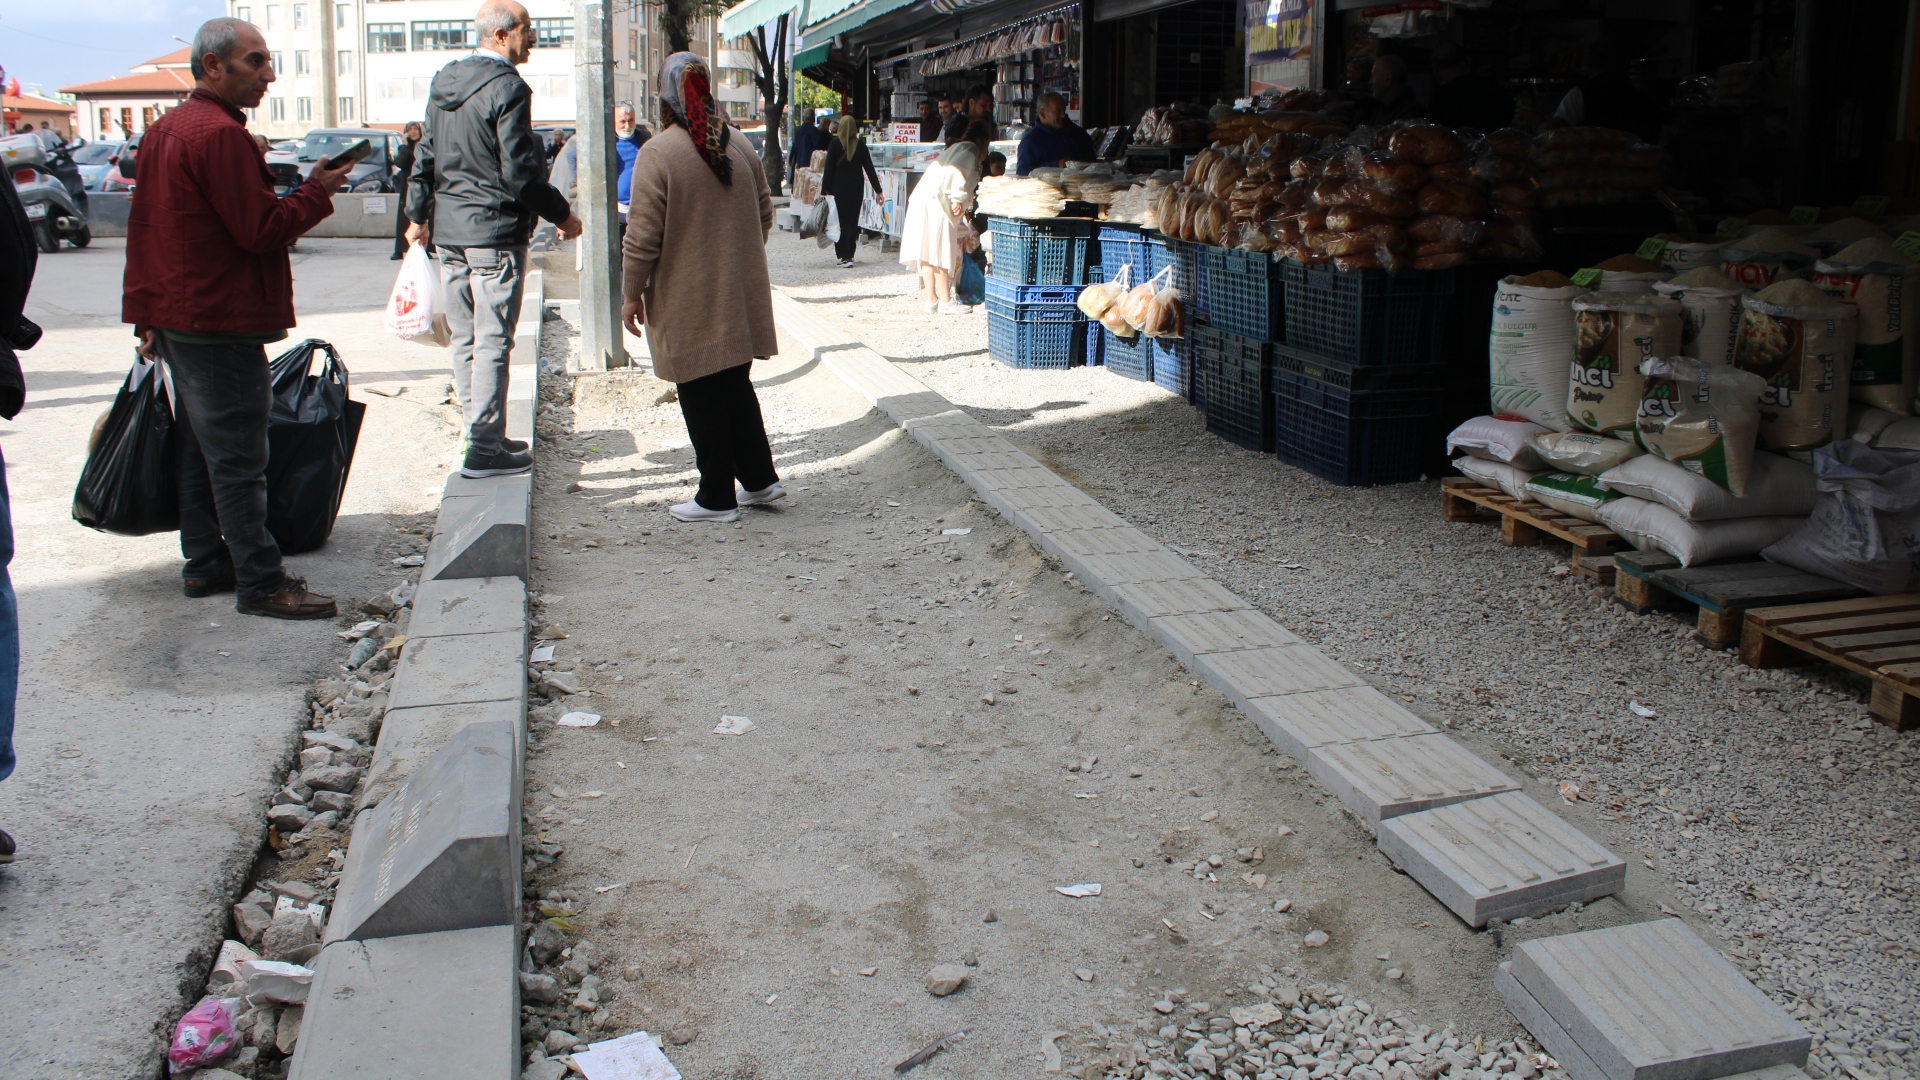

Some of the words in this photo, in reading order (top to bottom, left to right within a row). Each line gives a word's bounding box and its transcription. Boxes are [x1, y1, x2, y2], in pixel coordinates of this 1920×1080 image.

[1282, 18, 1301, 49] TAZE
[895, 135, 908, 143] 50
[1726, 301, 1740, 364] SMANCIK
[1888, 306, 1902, 333] Yerli
[1819, 354, 1834, 392] inci
[1573, 386, 1604, 403] Pirinç
